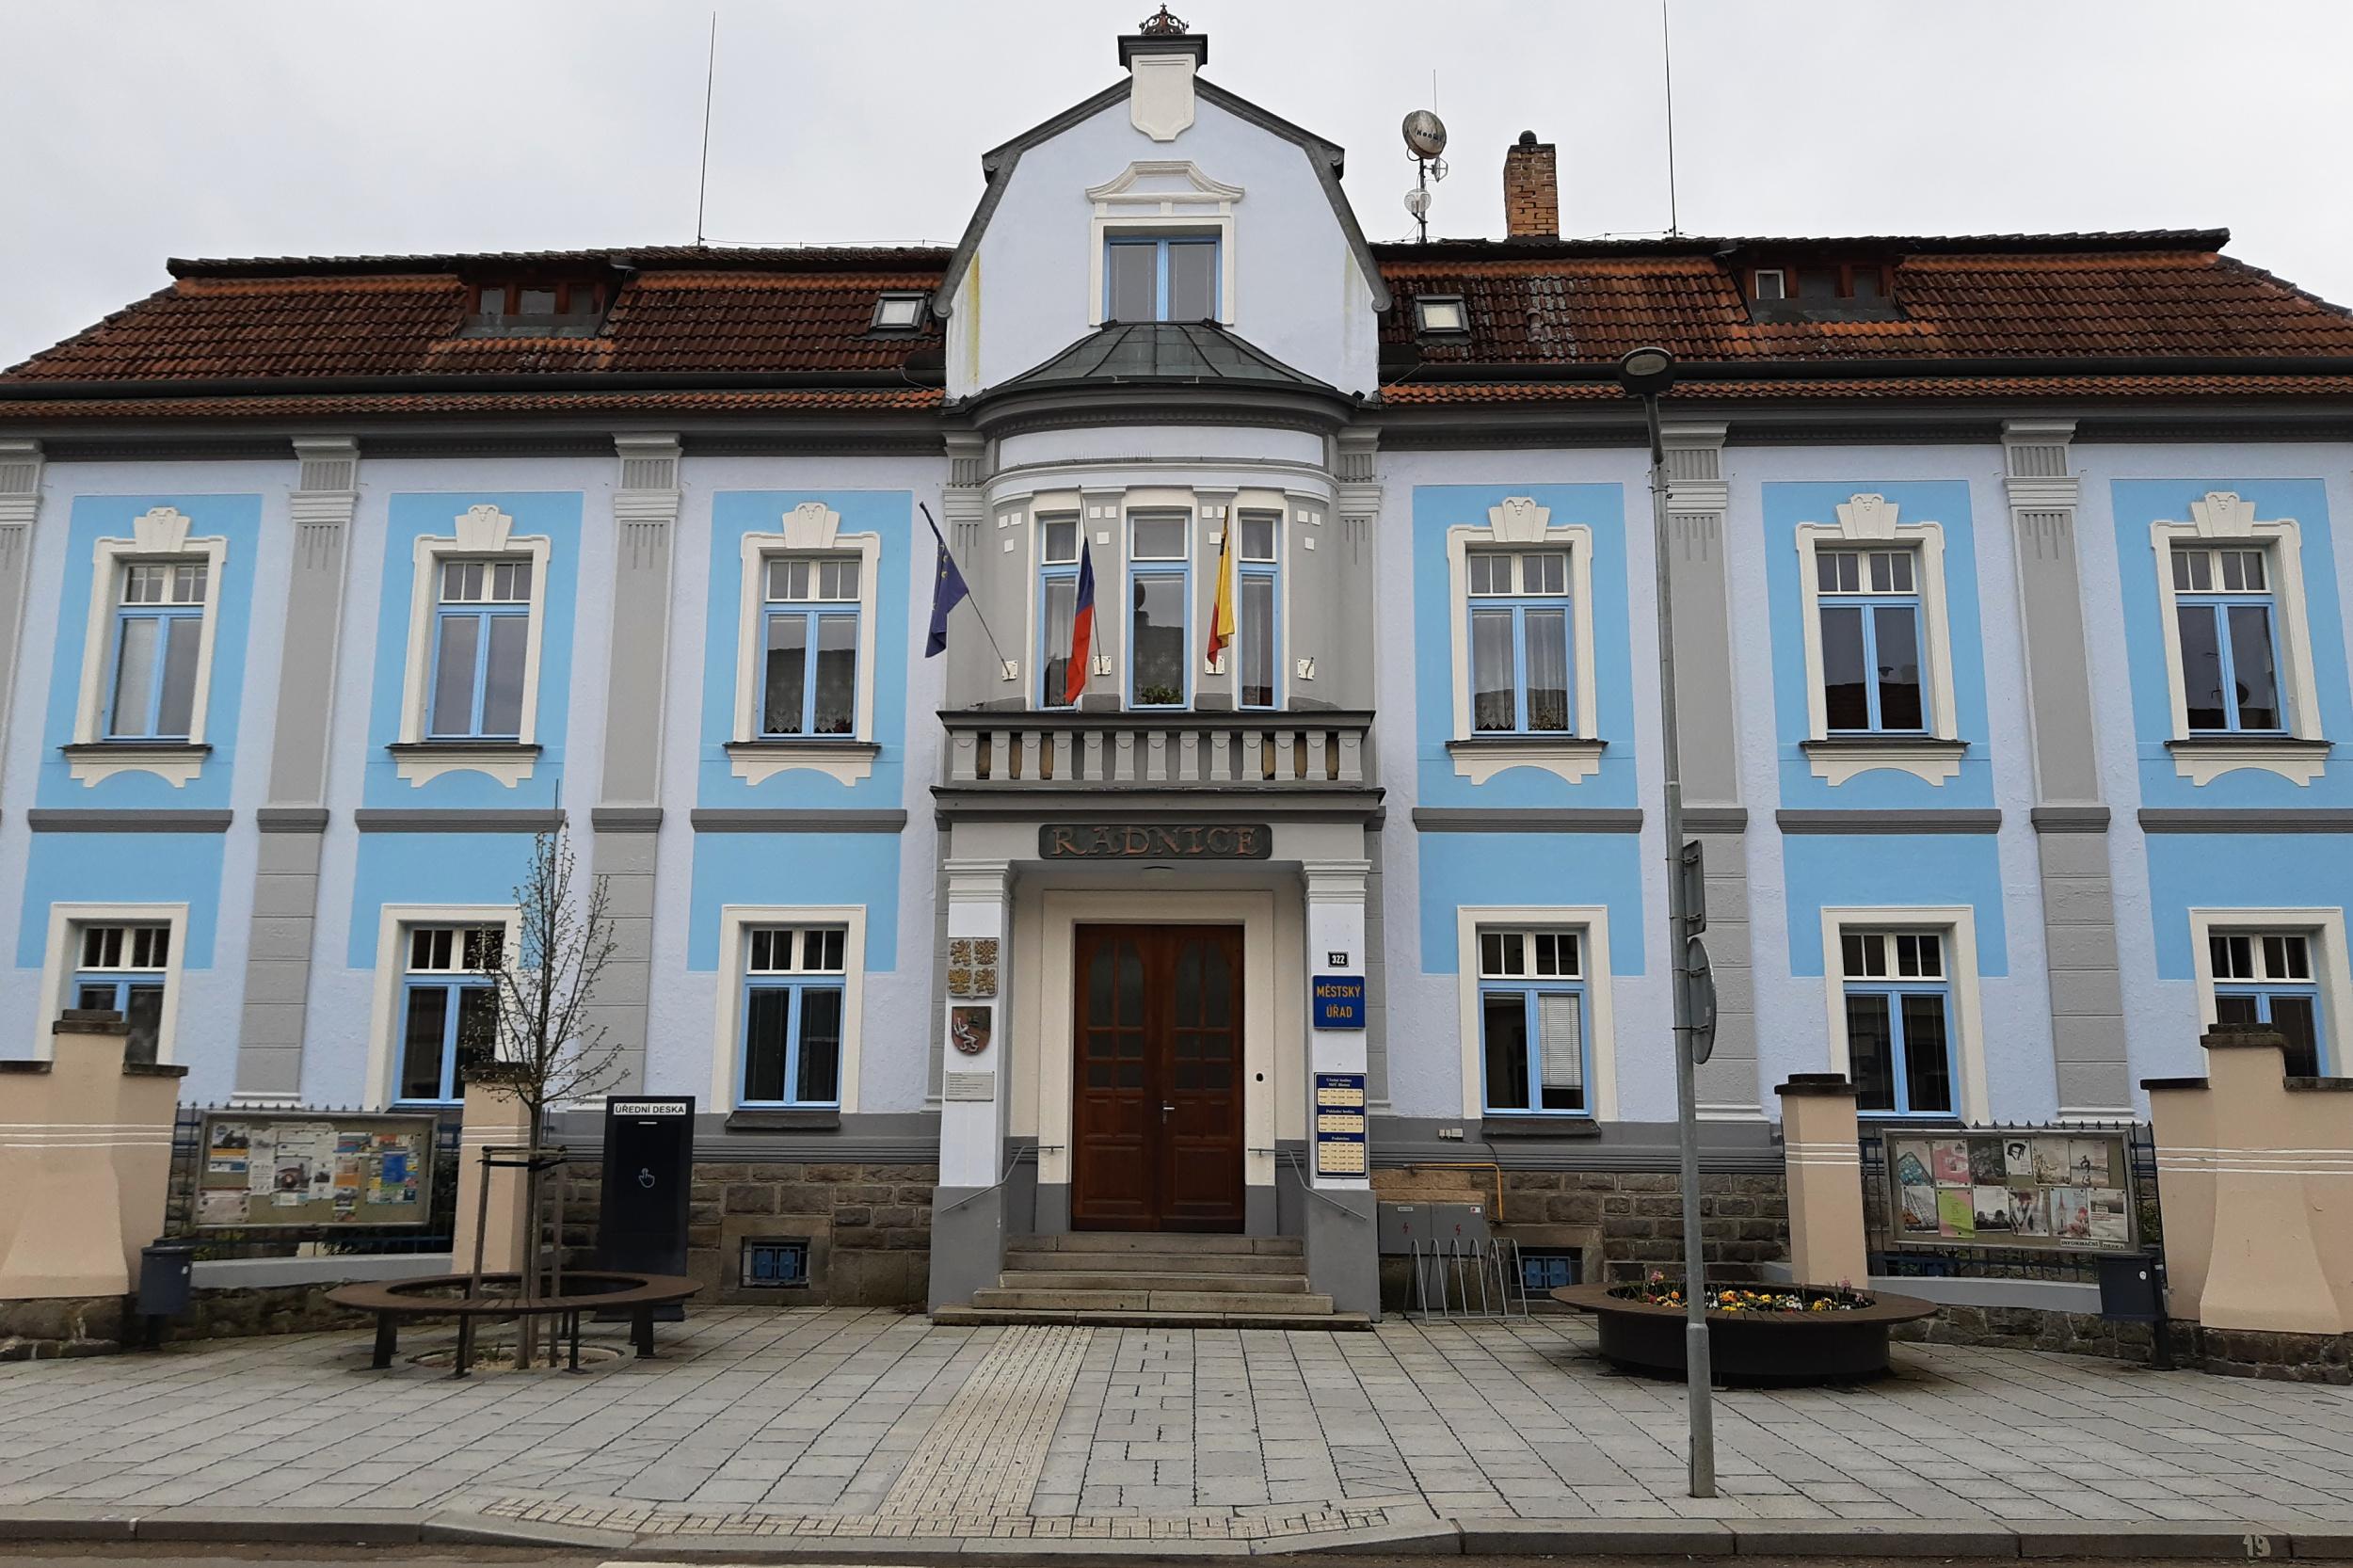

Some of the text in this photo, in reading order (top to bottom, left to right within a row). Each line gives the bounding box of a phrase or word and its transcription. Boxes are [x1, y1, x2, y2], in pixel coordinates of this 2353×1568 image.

[1051, 825, 1258, 856] RADNICE
[1332, 954, 1345, 965] 322
[1317, 984, 1361, 998] MĚSTSKÝ
[1326, 1004, 1353, 1017] ÚŘAD
[615, 1104, 684, 1113] ÚŘEDNÍ DESKA
[2243, 1534, 2271, 1558] 19
